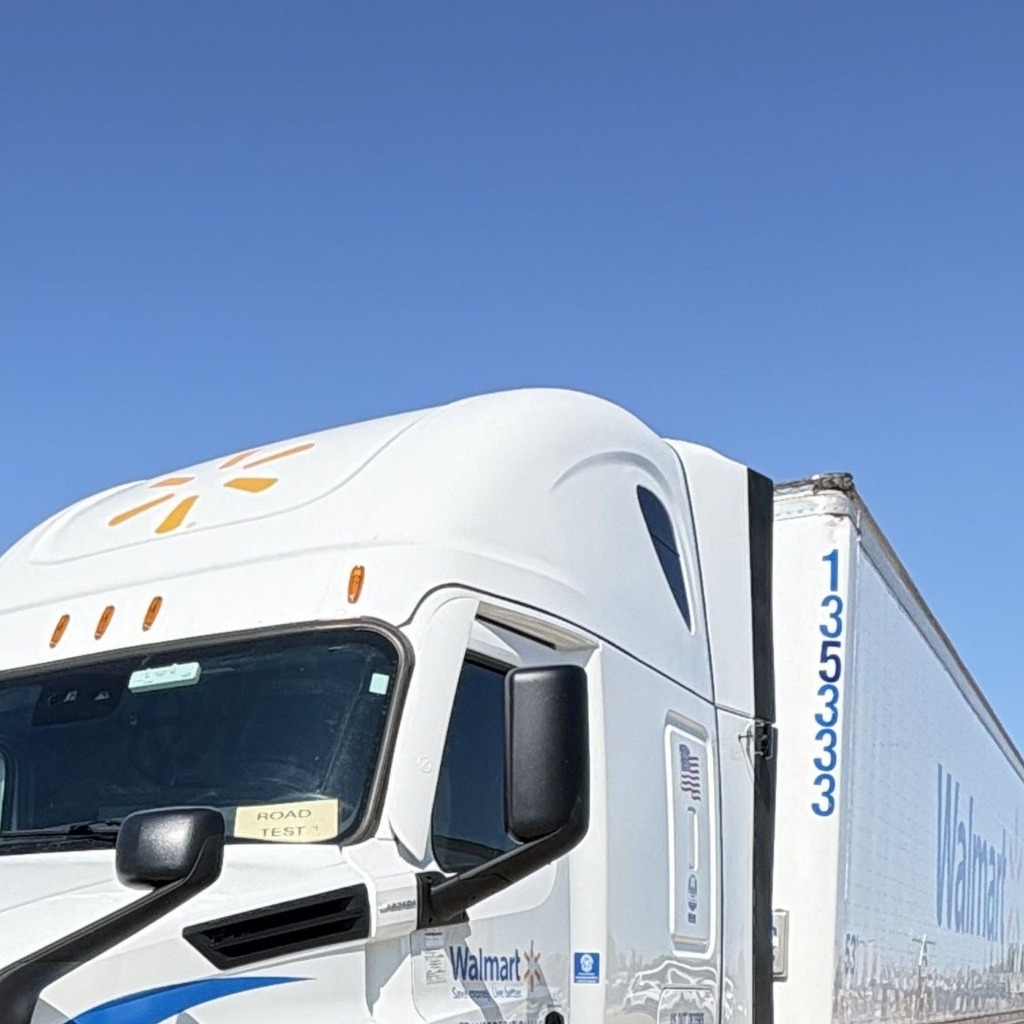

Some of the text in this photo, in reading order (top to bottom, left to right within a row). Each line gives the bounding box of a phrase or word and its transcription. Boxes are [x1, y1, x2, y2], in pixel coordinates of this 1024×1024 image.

[811, 549, 843, 817] 135333
[257, 809, 312, 821] ROAD
[261, 826, 304, 837] TEST
[936, 762, 1007, 945] Walmart
[449, 946, 521, 981] Walmart
